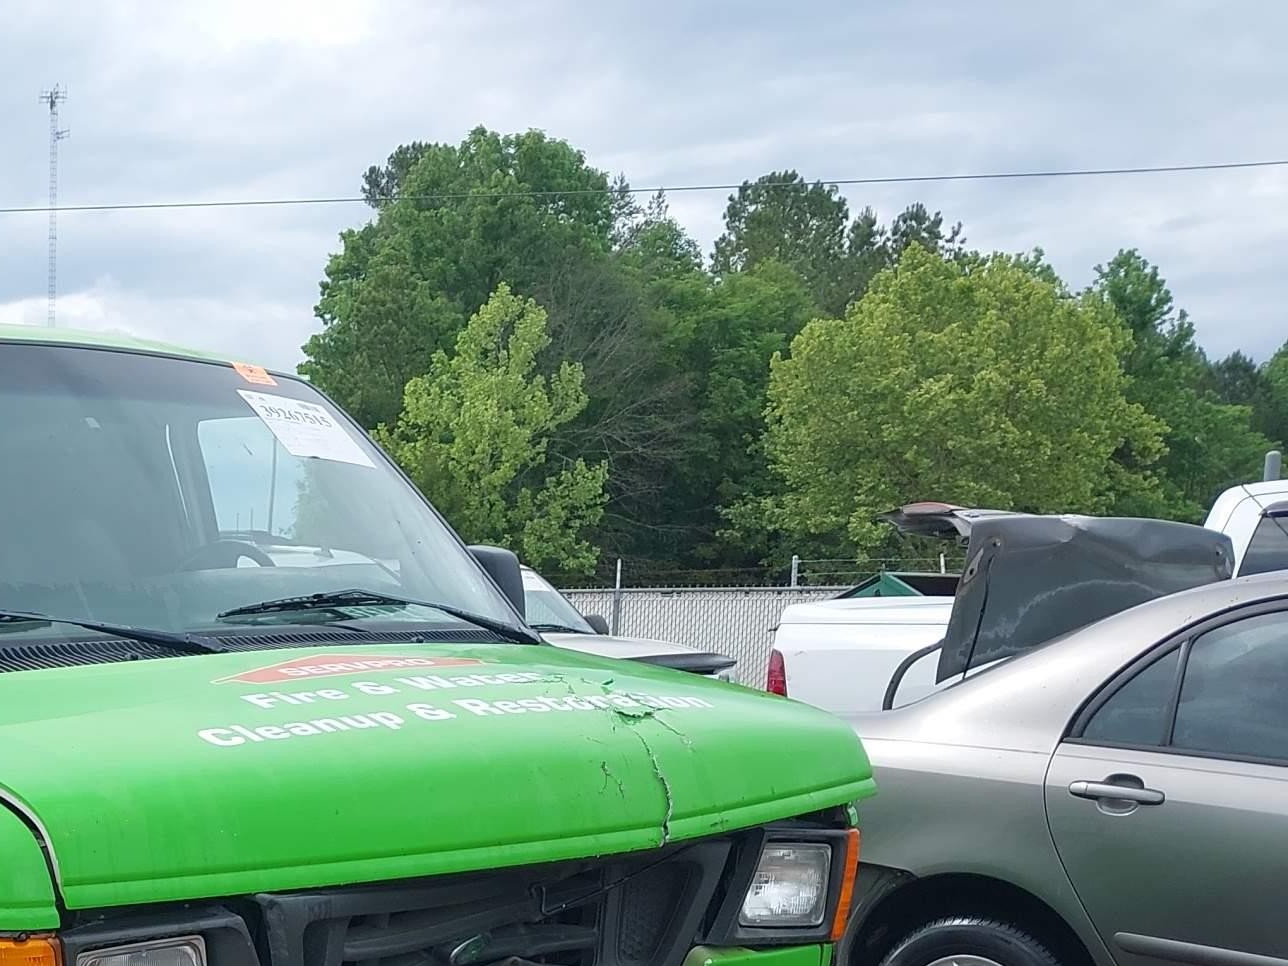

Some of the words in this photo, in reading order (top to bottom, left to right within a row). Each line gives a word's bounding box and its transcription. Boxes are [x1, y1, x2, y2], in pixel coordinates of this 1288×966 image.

[260, 405, 332, 428] 39267515
[277, 658, 435, 676] SERVPRO
[240, 688, 349, 709] Fire
[351, 681, 402, 696] &
[394, 670, 542, 691] Water
[198, 711, 405, 747] Cleanup
[405, 703, 458, 721] &
[452, 691, 715, 718] Restoration
